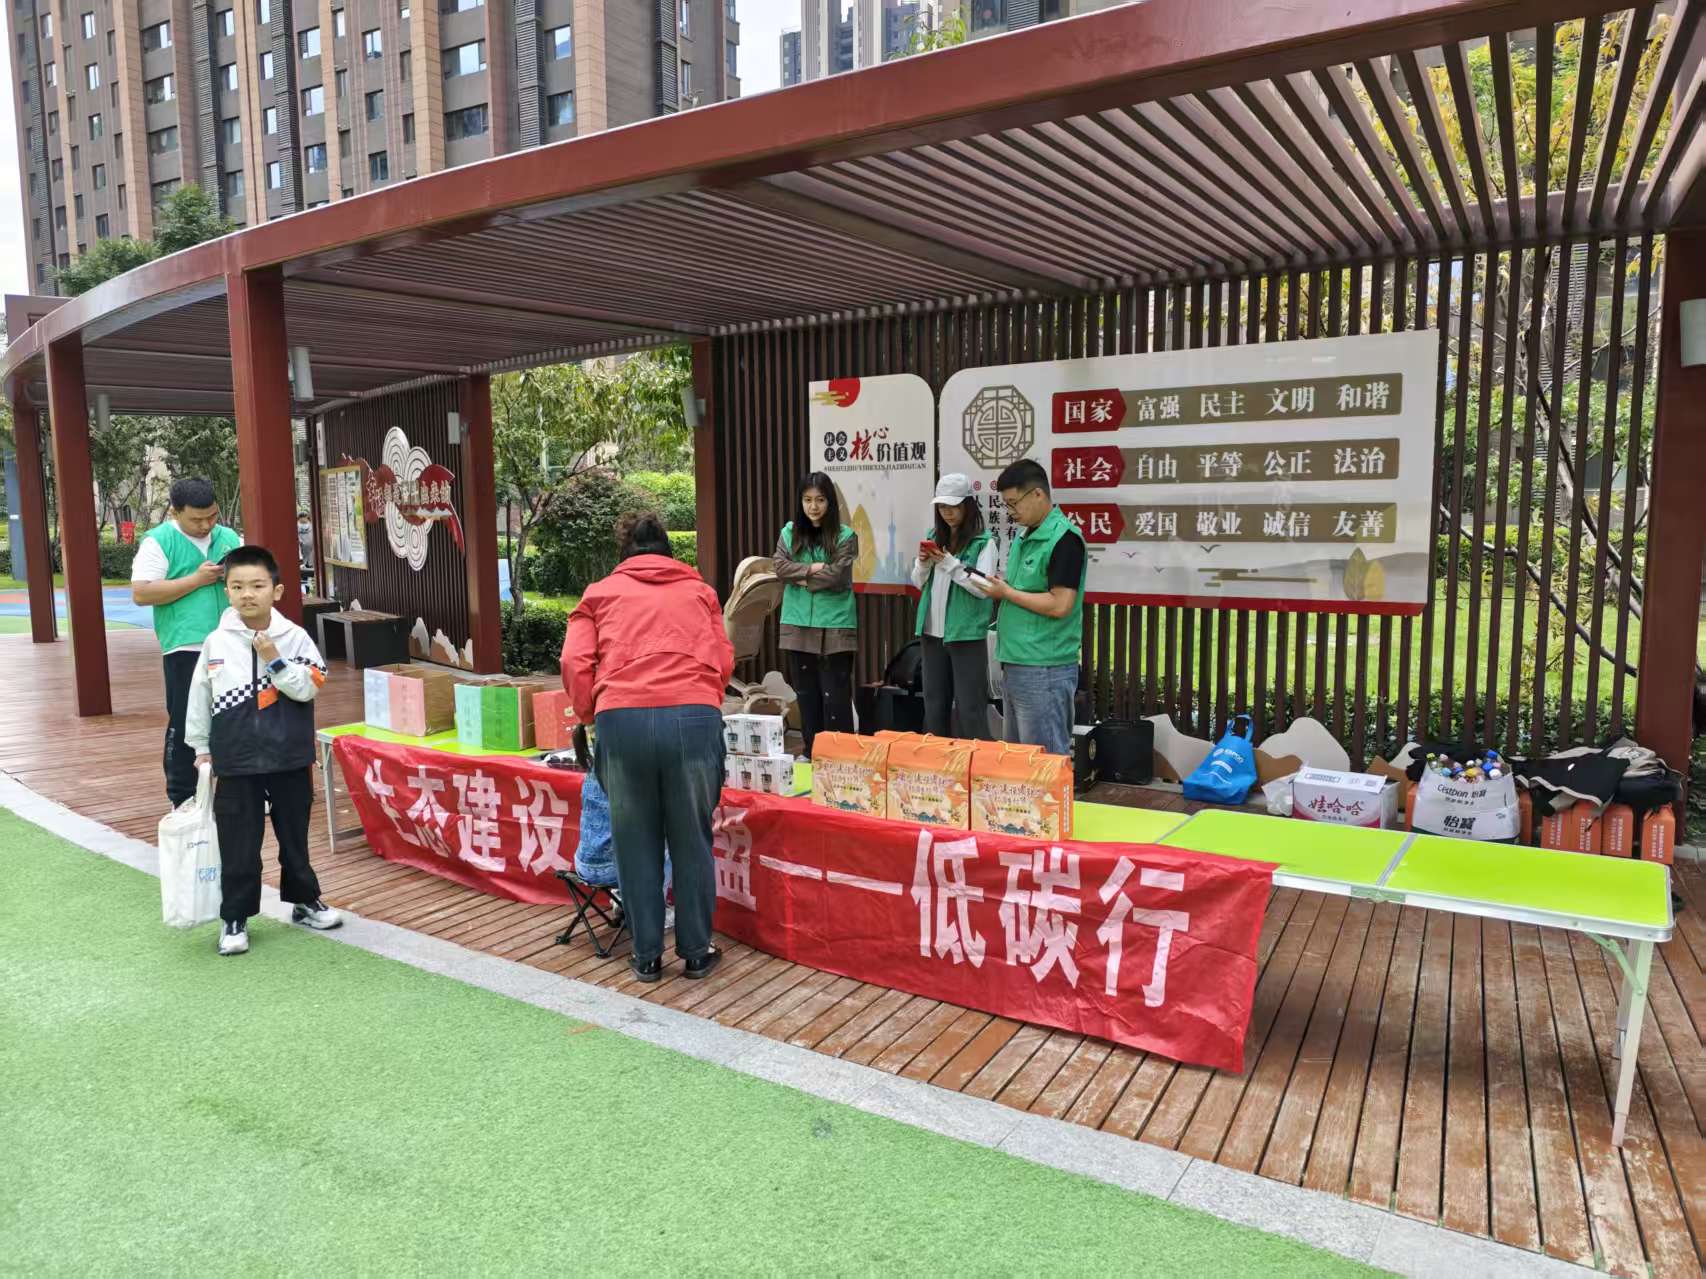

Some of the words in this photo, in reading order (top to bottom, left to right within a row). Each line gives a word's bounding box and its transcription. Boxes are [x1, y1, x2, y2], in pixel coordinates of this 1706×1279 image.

[1064, 399, 1113, 424] 国家
[1137, 395, 1180, 421] 富强
[1200, 391, 1245, 418] 民主
[1264, 386, 1316, 415] 文明
[1336, 381, 1390, 411] 和谐
[1064, 456, 1113, 482] 社会
[1136, 453, 1177, 480] 自由
[1197, 450, 1243, 478] 平等
[1264, 450, 1313, 476] 公正
[1334, 446, 1386, 474] 法治
[1135, 511, 1178, 537] 爱国
[1196, 511, 1243, 536] 敬业
[1263, 511, 1312, 537] 诚信
[1332, 510, 1385, 538] 友善
[1308, 795, 1363, 816] 娃哈哈
